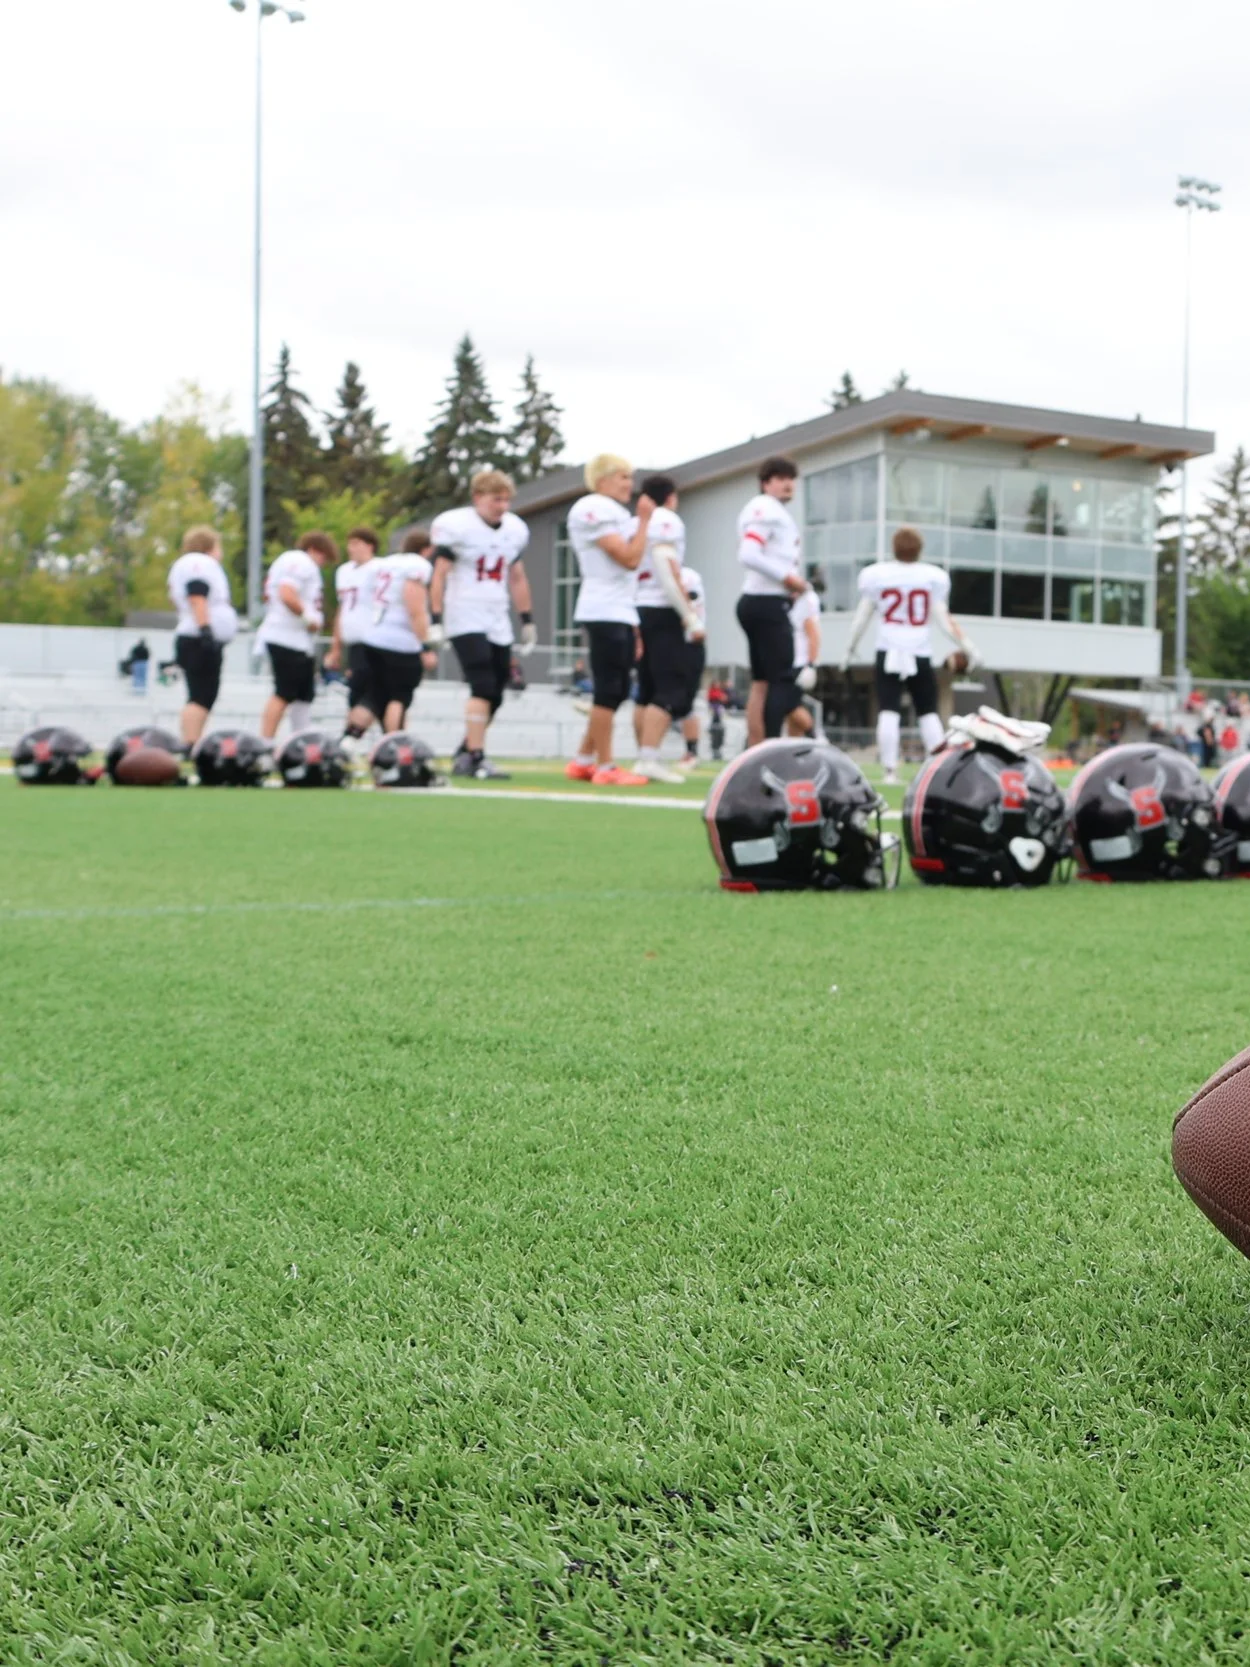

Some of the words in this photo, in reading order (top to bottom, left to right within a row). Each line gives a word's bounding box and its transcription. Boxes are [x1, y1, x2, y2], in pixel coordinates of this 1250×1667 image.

[476, 554, 505, 582] 14
[880, 587, 931, 627] 20
[784, 779, 821, 825] S
[1000, 769, 1029, 810] S
[1129, 785, 1166, 829] S
